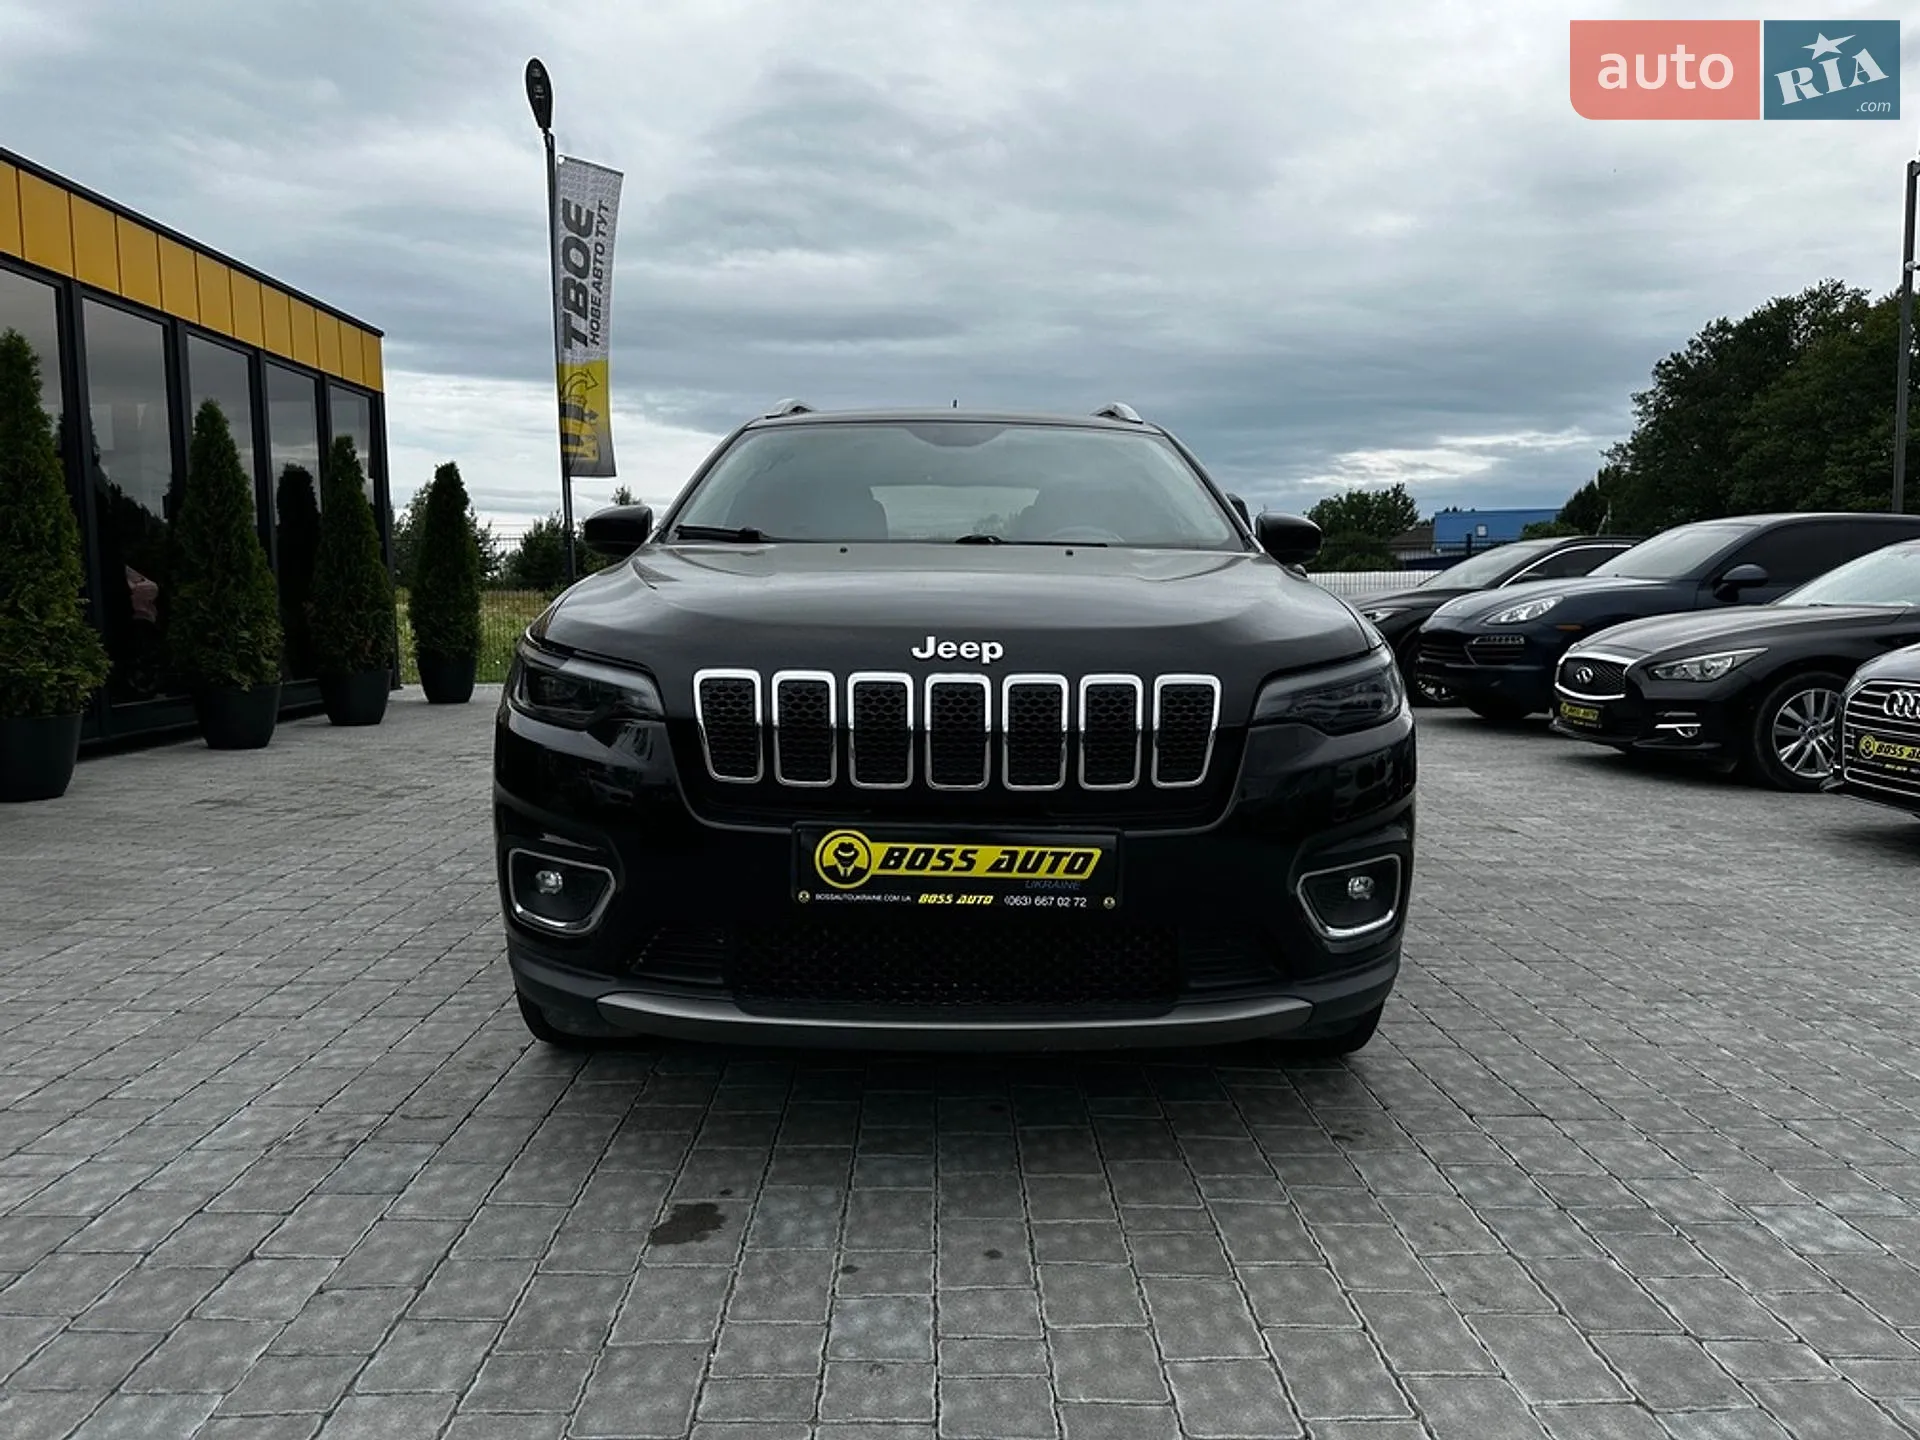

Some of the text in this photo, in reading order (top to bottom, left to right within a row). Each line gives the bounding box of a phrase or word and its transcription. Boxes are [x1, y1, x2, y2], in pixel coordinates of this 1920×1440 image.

[561, 198, 595, 349] ТВОЕ
[590, 199, 609, 346] НОВЕ АВТО ТУТ
[911, 636, 1004, 664] Jeep
[878, 846, 1096, 874] BOSS AUTO
[918, 893, 994, 905] BOSS AUTO
[1025, 880, 1081, 891] UKRAINE
[1057, 896, 1071, 908] 02
[1073, 897, 1087, 908] 72
